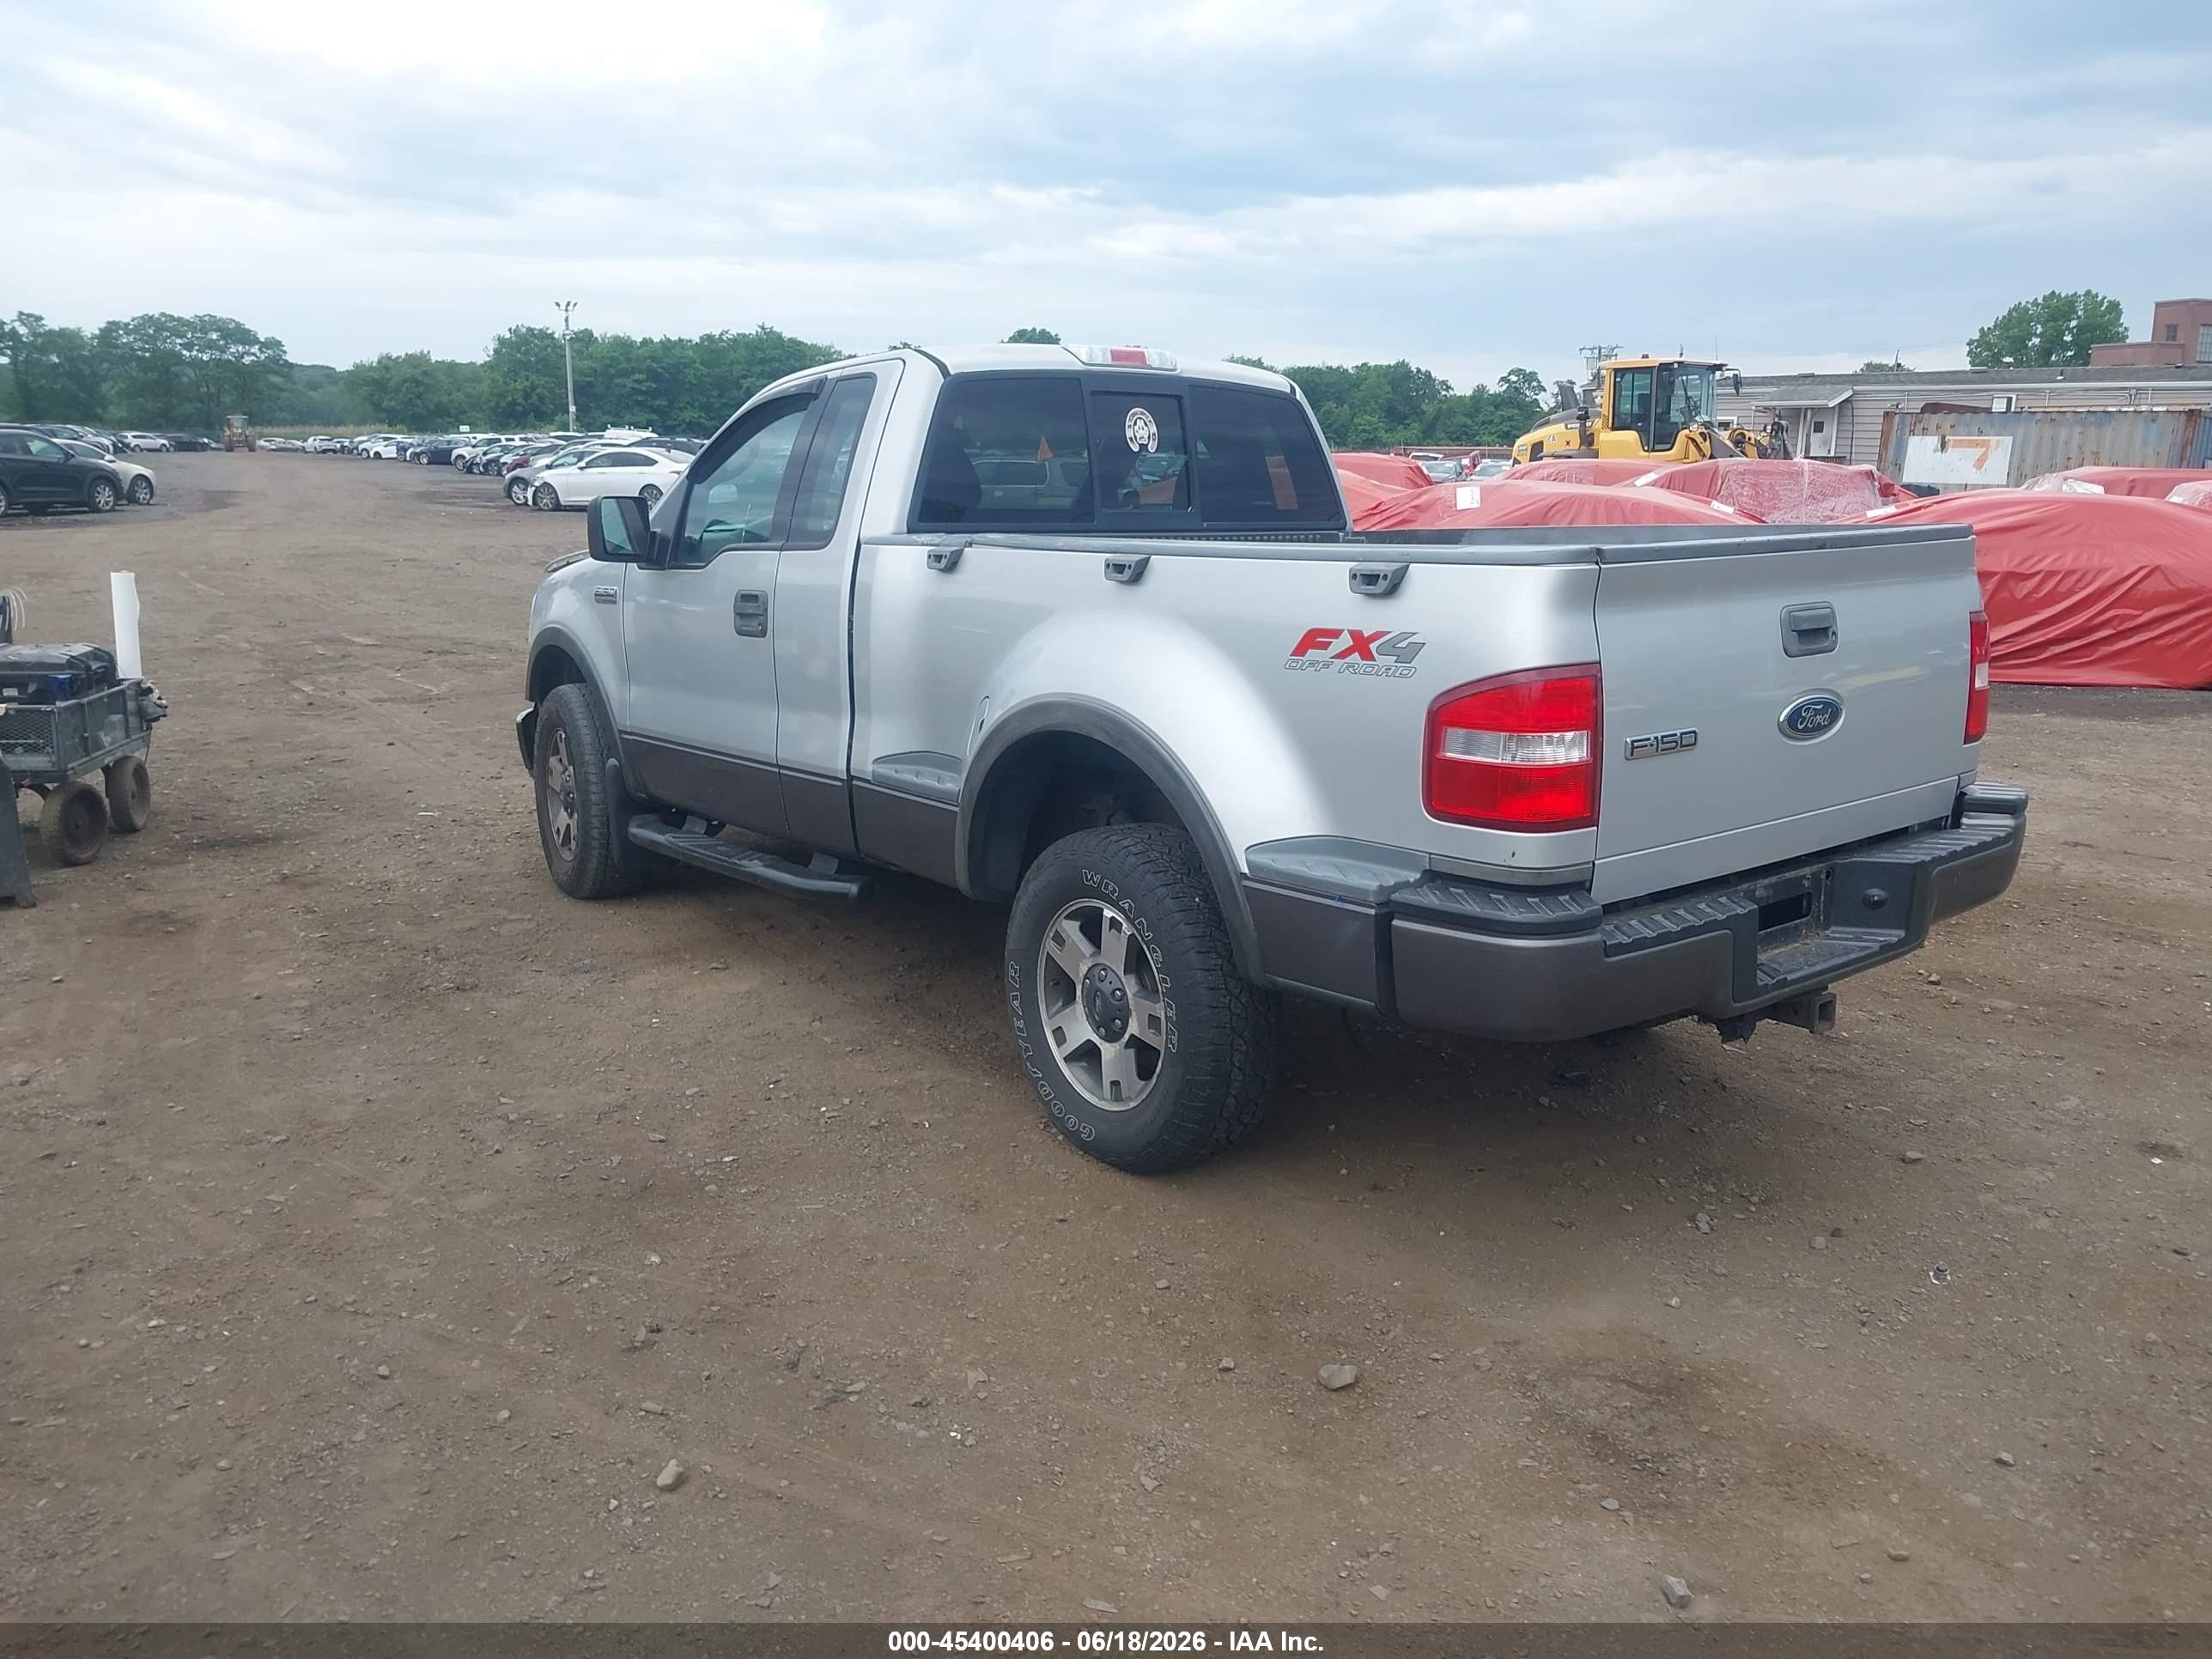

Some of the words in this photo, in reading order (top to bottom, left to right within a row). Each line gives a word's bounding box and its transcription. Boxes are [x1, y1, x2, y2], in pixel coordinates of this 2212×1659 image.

[1290, 628, 1426, 665] FX4
[1285, 659, 1334, 672] OFF
[1338, 662, 1417, 678] ROAD
[1797, 704, 1832, 730] Ford
[1081, 869, 1176, 1053] WRANGLER
[1009, 962, 1096, 1140] GOODYEAR
